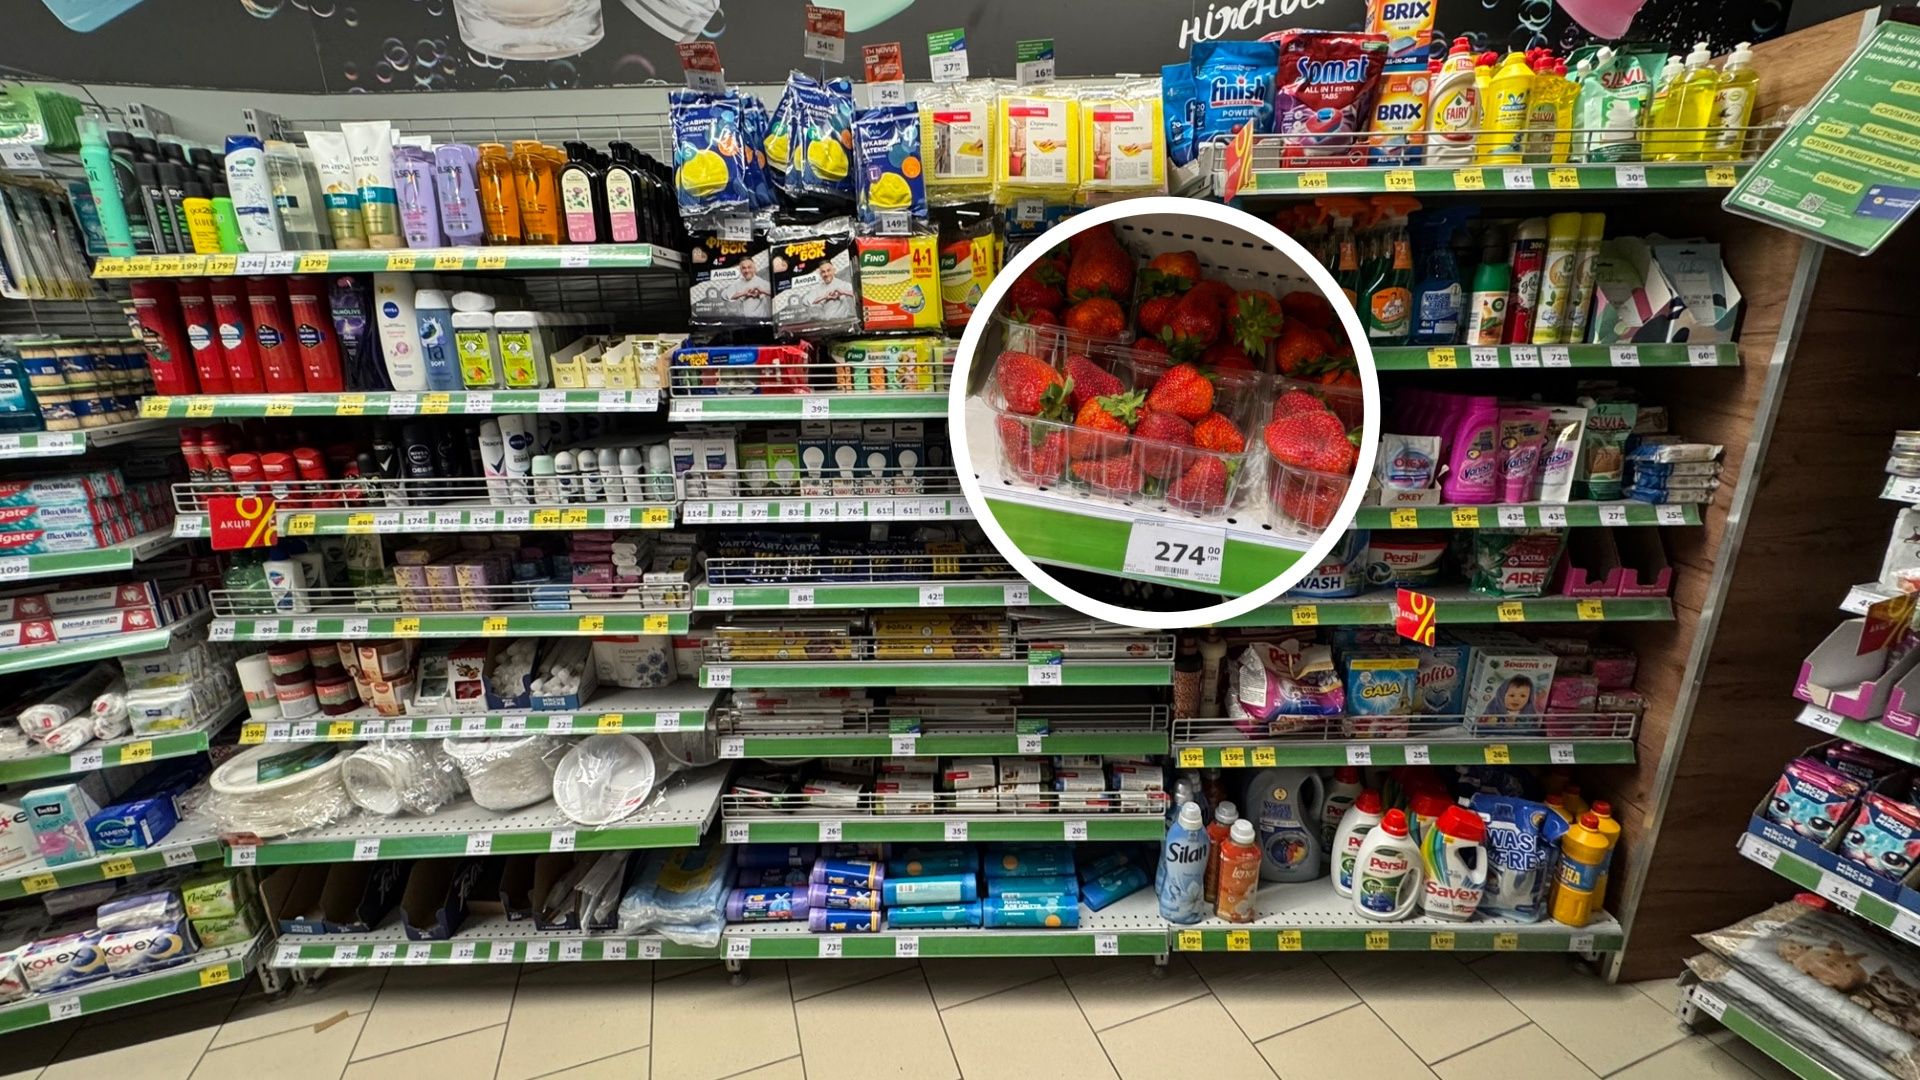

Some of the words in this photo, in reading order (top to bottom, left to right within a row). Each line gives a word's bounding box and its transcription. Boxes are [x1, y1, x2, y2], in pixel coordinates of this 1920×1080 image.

[1382, 1, 1432, 22] BRIX
[1296, 55, 1369, 84] Somat
[1848, 69, 1860, 81] 1
[1600, 67, 1648, 88] SILVI
[1210, 75, 1266, 103] finish
[1304, 86, 1320, 94] ALL
[1826, 93, 1841, 105] 2
[1376, 102, 1424, 122] BRIX
[1445, 106, 1470, 121] FAIRY
[1807, 114, 1821, 126] 3
[1788, 139, 1800, 150] 4
[1768, 158, 1782, 170] 5
[799, 247, 826, 261] БОК
[863, 253, 886, 263] FINO
[912, 248, 933, 265] 4+1
[1538, 450, 1575, 467] anish
[1397, 493, 1424, 502] OKEY
[0, 507, 29, 521] gate
[219, 518, 251, 530] АКЦІЯ
[0, 532, 35, 544] lgate
[1155, 541, 1206, 565] 274
[1208, 547, 1221, 555] 00
[1383, 552, 1419, 563] Persil
[1505, 573, 1545, 585] ARIE
[1361, 682, 1402, 698] GALA
[1486, 828, 1538, 853] WAS
[1166, 843, 1208, 863] Silan
[1370, 857, 1408, 871] Persil
[1423, 881, 1481, 902] Savex
